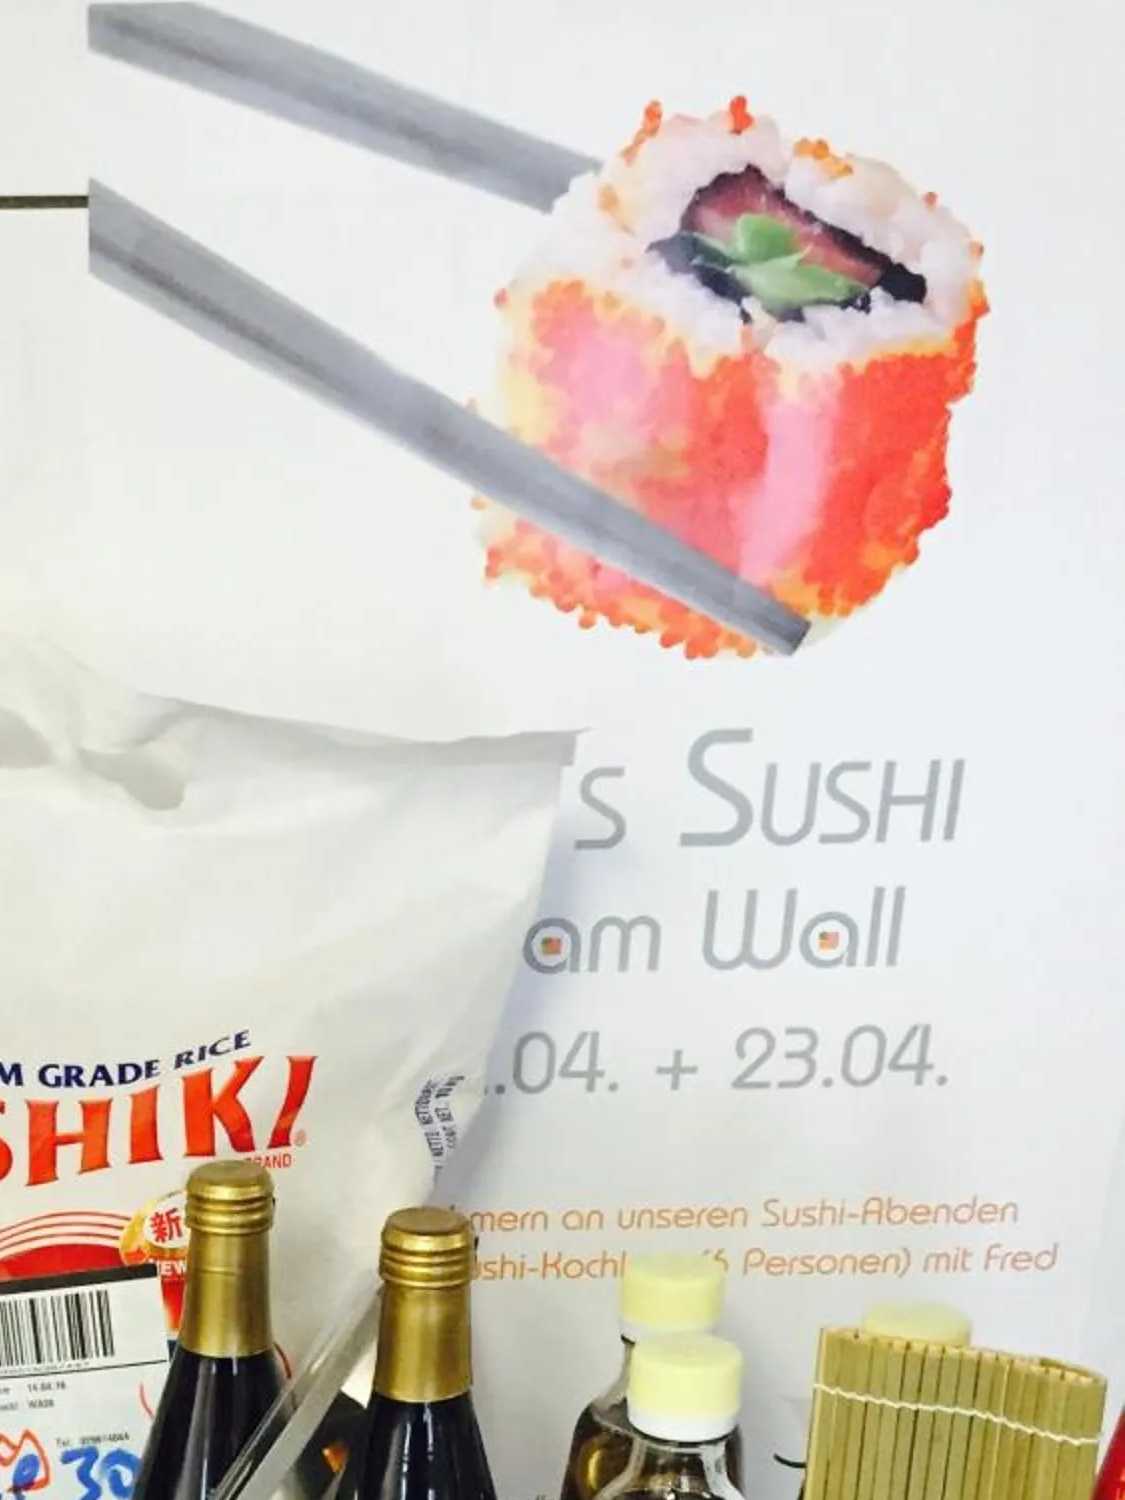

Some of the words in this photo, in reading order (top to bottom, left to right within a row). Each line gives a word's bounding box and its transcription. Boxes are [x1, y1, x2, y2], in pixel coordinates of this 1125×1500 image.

[679, 727, 967, 849] SUSHI
[522, 914, 662, 976] am
[700, 886, 907, 971] Wall
[38, 1057, 161, 1090] GRADE
[175, 1029, 252, 1070] RICE
[731, 1023, 950, 1091] 23.04.
[561, 1209, 604, 1231] an
[617, 1204, 749, 1231] unseren
[761, 1194, 1020, 1229] Sushi-Abenden
[742, 1246, 912, 1279] Personen)
[923, 1247, 974, 1274] mit
[983, 1241, 1060, 1273] Fred
